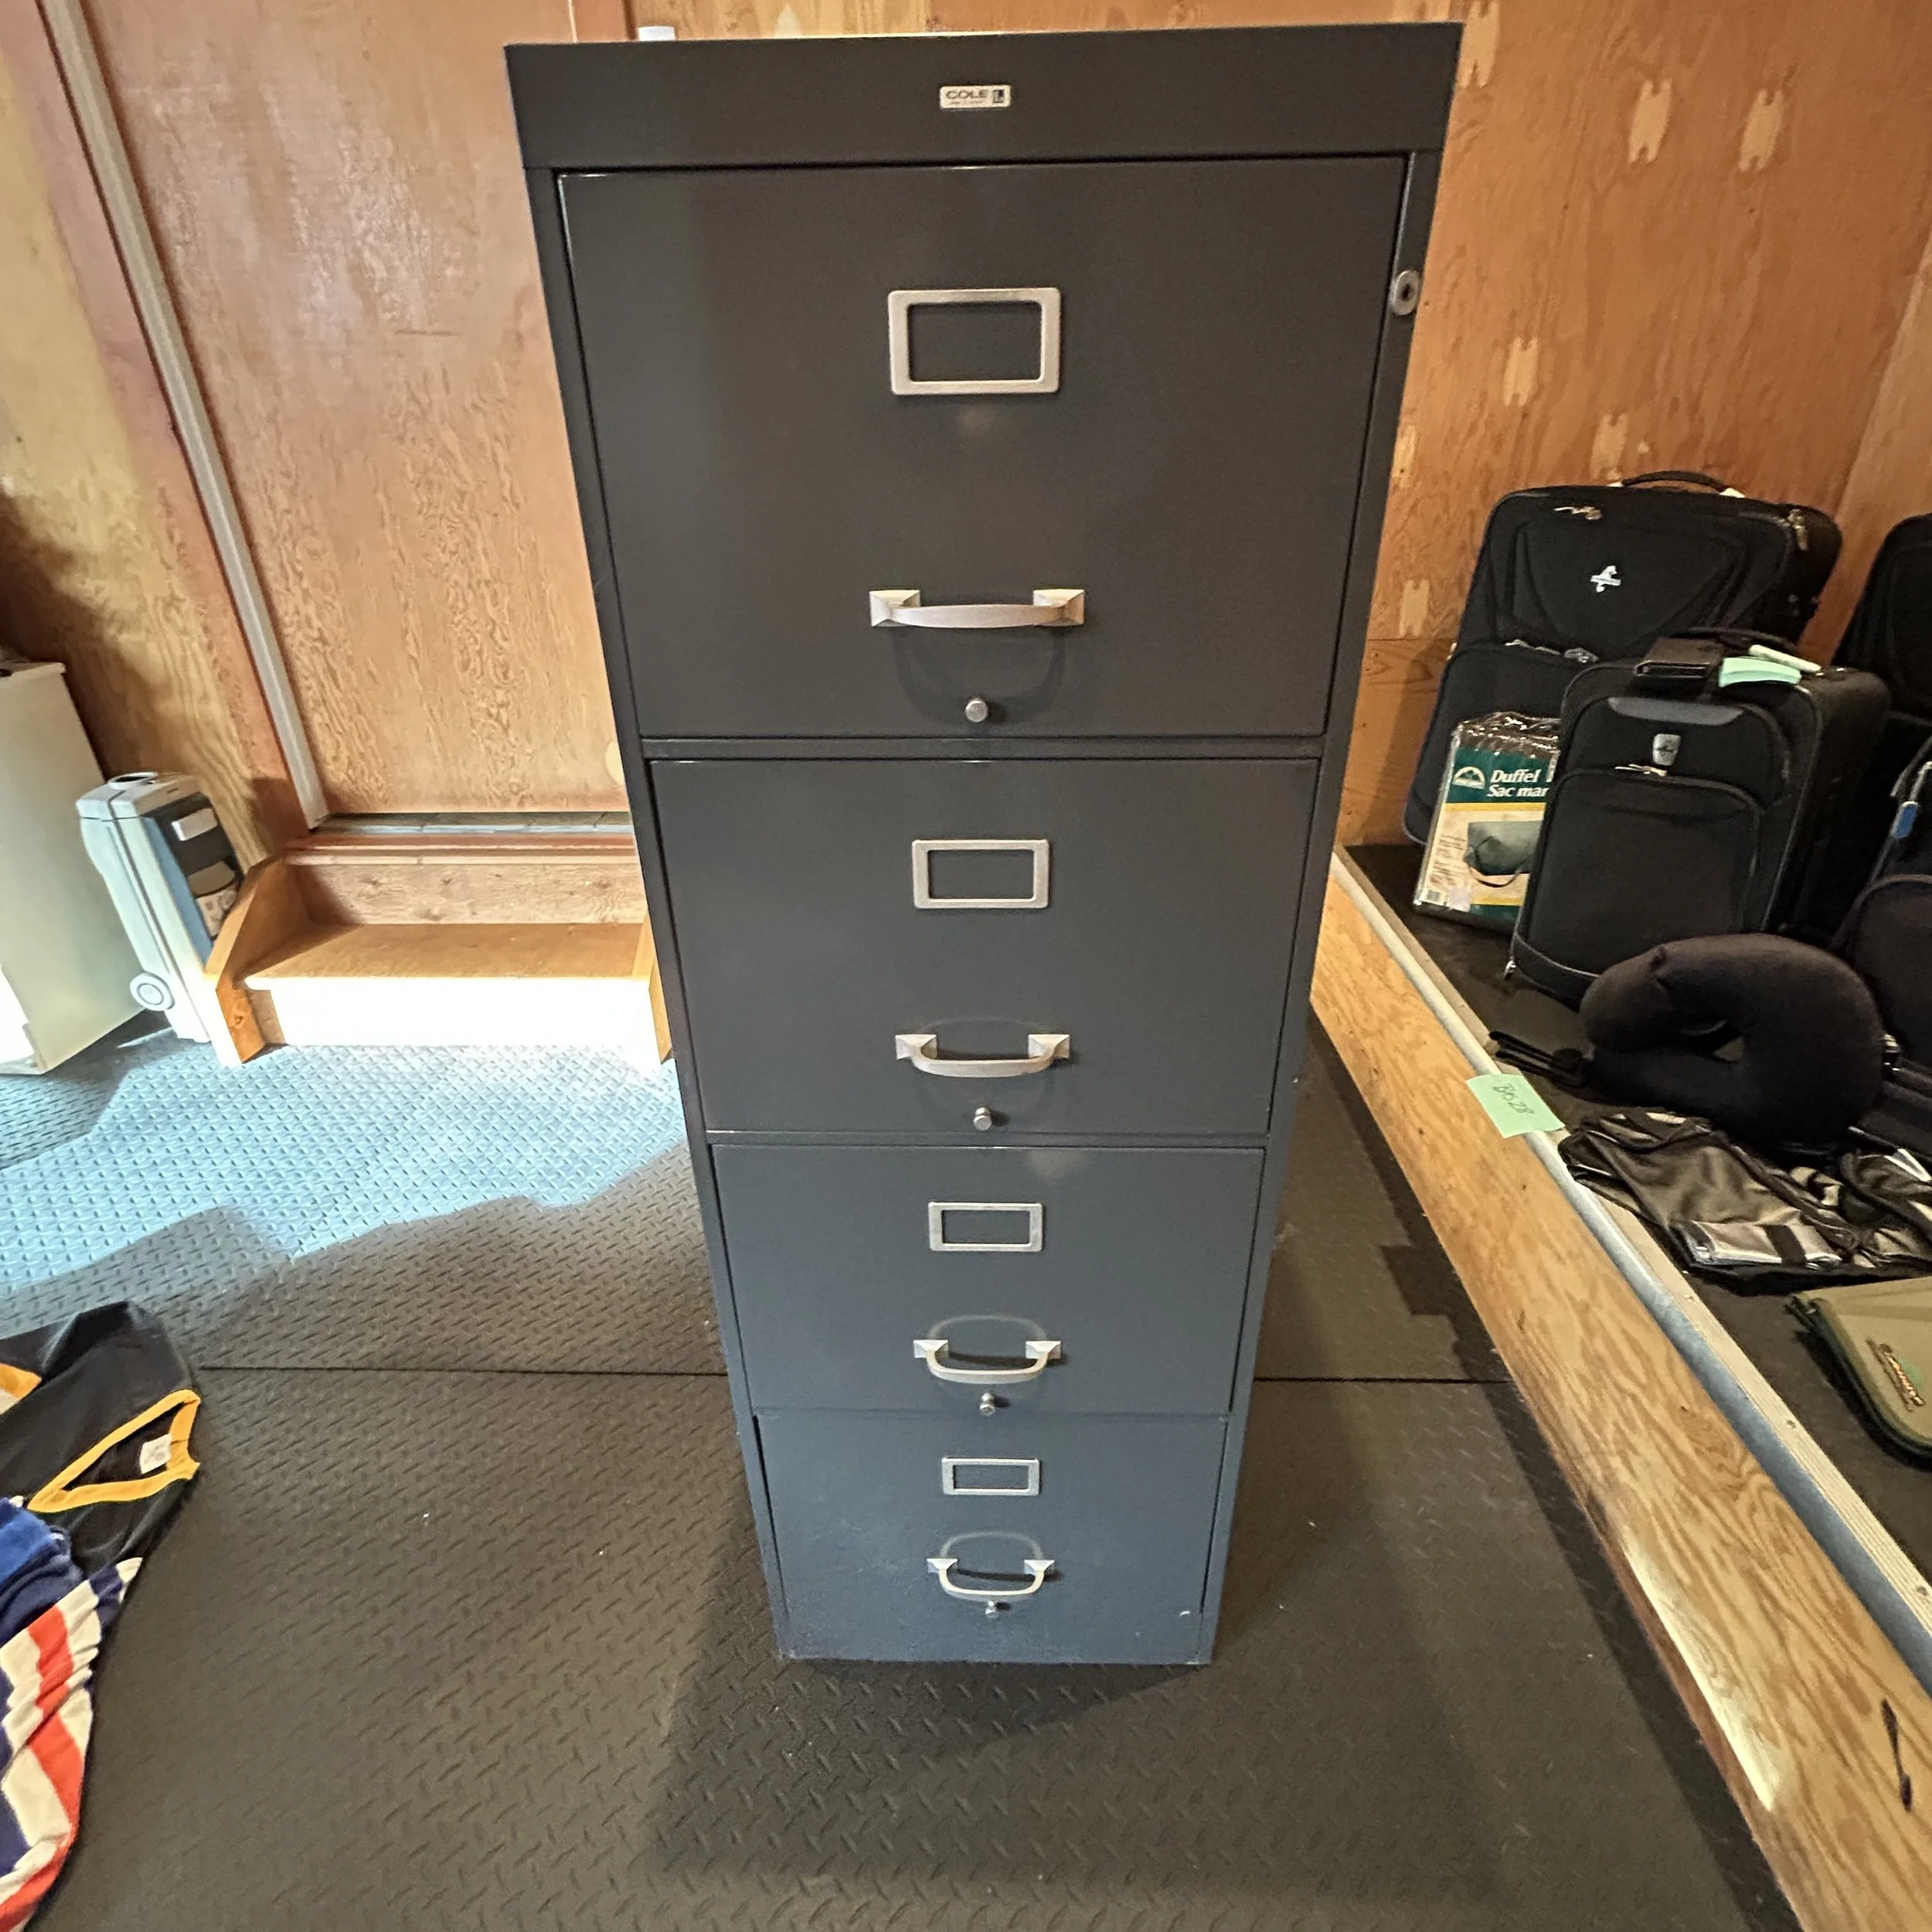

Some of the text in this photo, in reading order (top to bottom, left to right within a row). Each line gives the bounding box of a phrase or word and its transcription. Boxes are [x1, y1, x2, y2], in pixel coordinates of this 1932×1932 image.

[946, 90, 988, 99] COLE
[1491, 769, 1542, 783] Duffel
[1487, 784, 1515, 797] Sac
